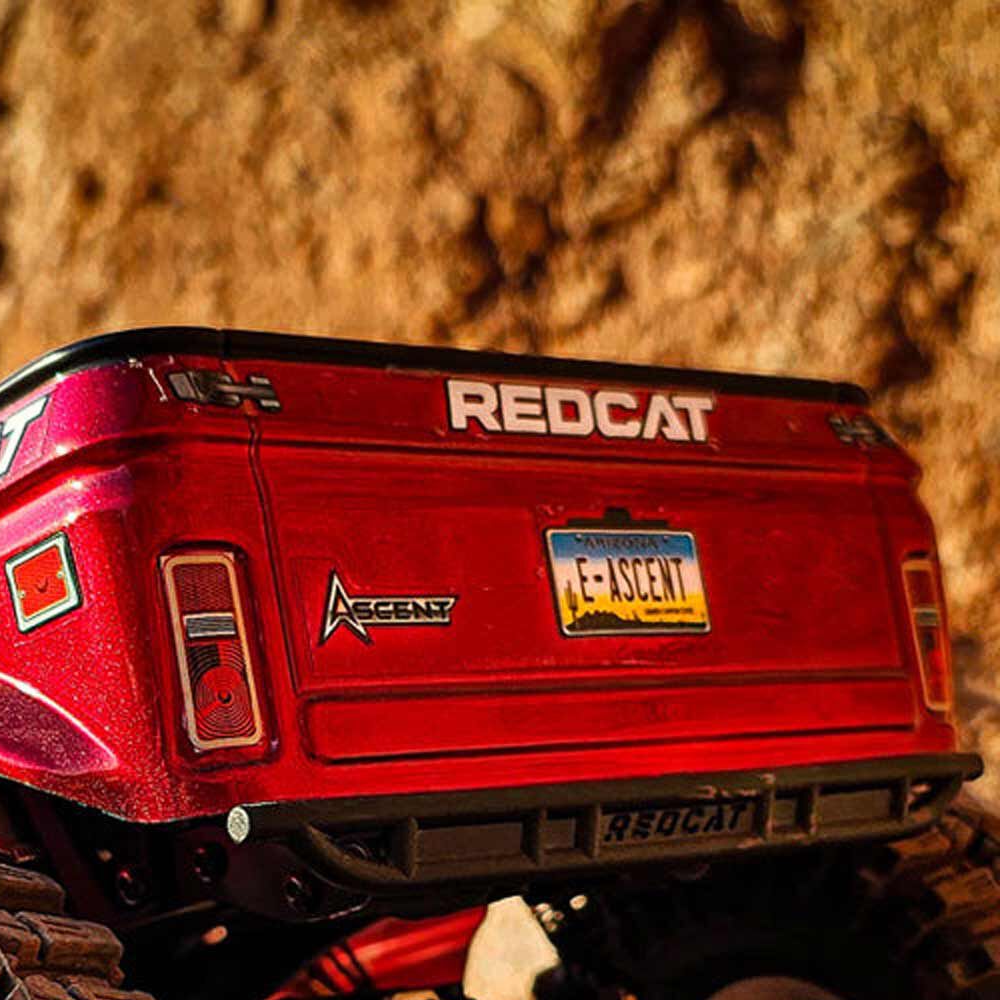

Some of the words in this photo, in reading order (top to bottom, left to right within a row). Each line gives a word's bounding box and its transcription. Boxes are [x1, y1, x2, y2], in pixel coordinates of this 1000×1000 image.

[446, 379, 713, 442] REDCAT
[317, 569, 459, 645] ASCENT
[575, 557, 687, 603] E-ASCENT
[603, 802, 749, 842] REDCAT
